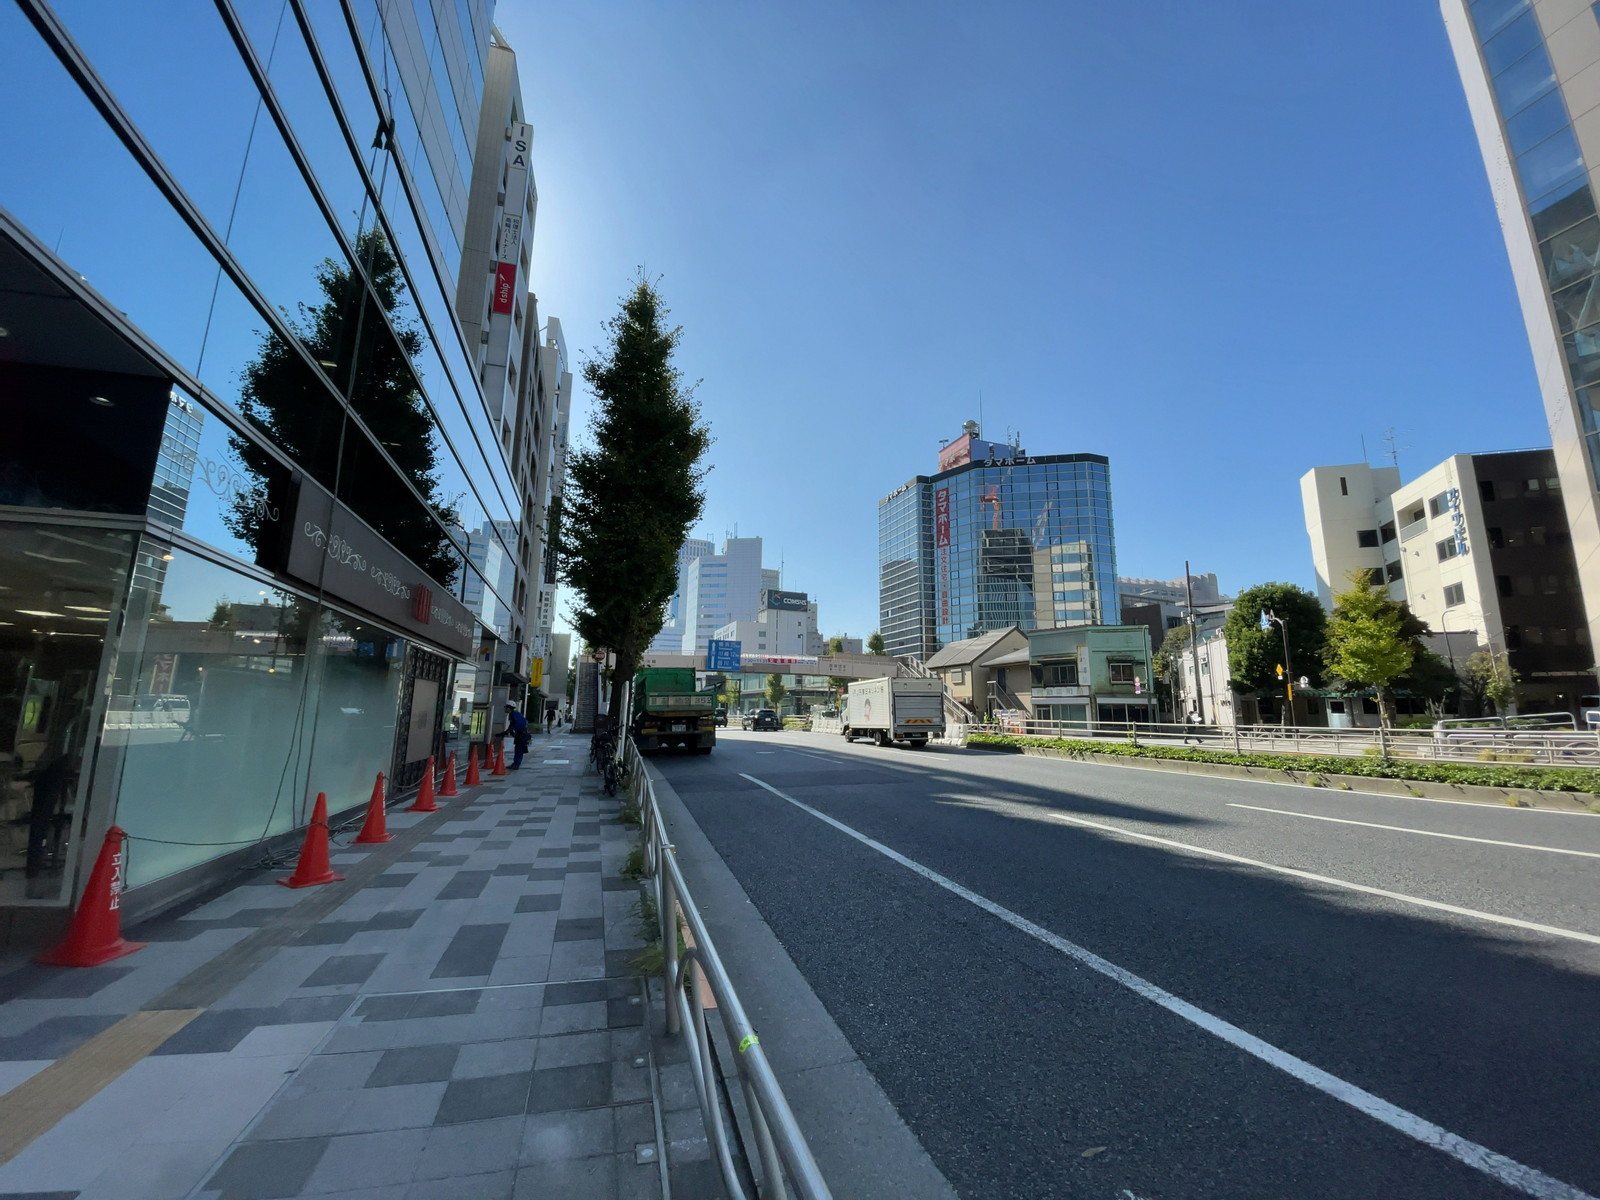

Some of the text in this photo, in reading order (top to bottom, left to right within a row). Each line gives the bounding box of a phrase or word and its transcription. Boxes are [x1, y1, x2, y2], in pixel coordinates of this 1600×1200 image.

[512, 126, 526, 167] ISA
[983, 456, 1036, 467] タマホーム
[937, 490, 949, 545] タマホーム
[109, 852, 122, 911] 立入禁止
